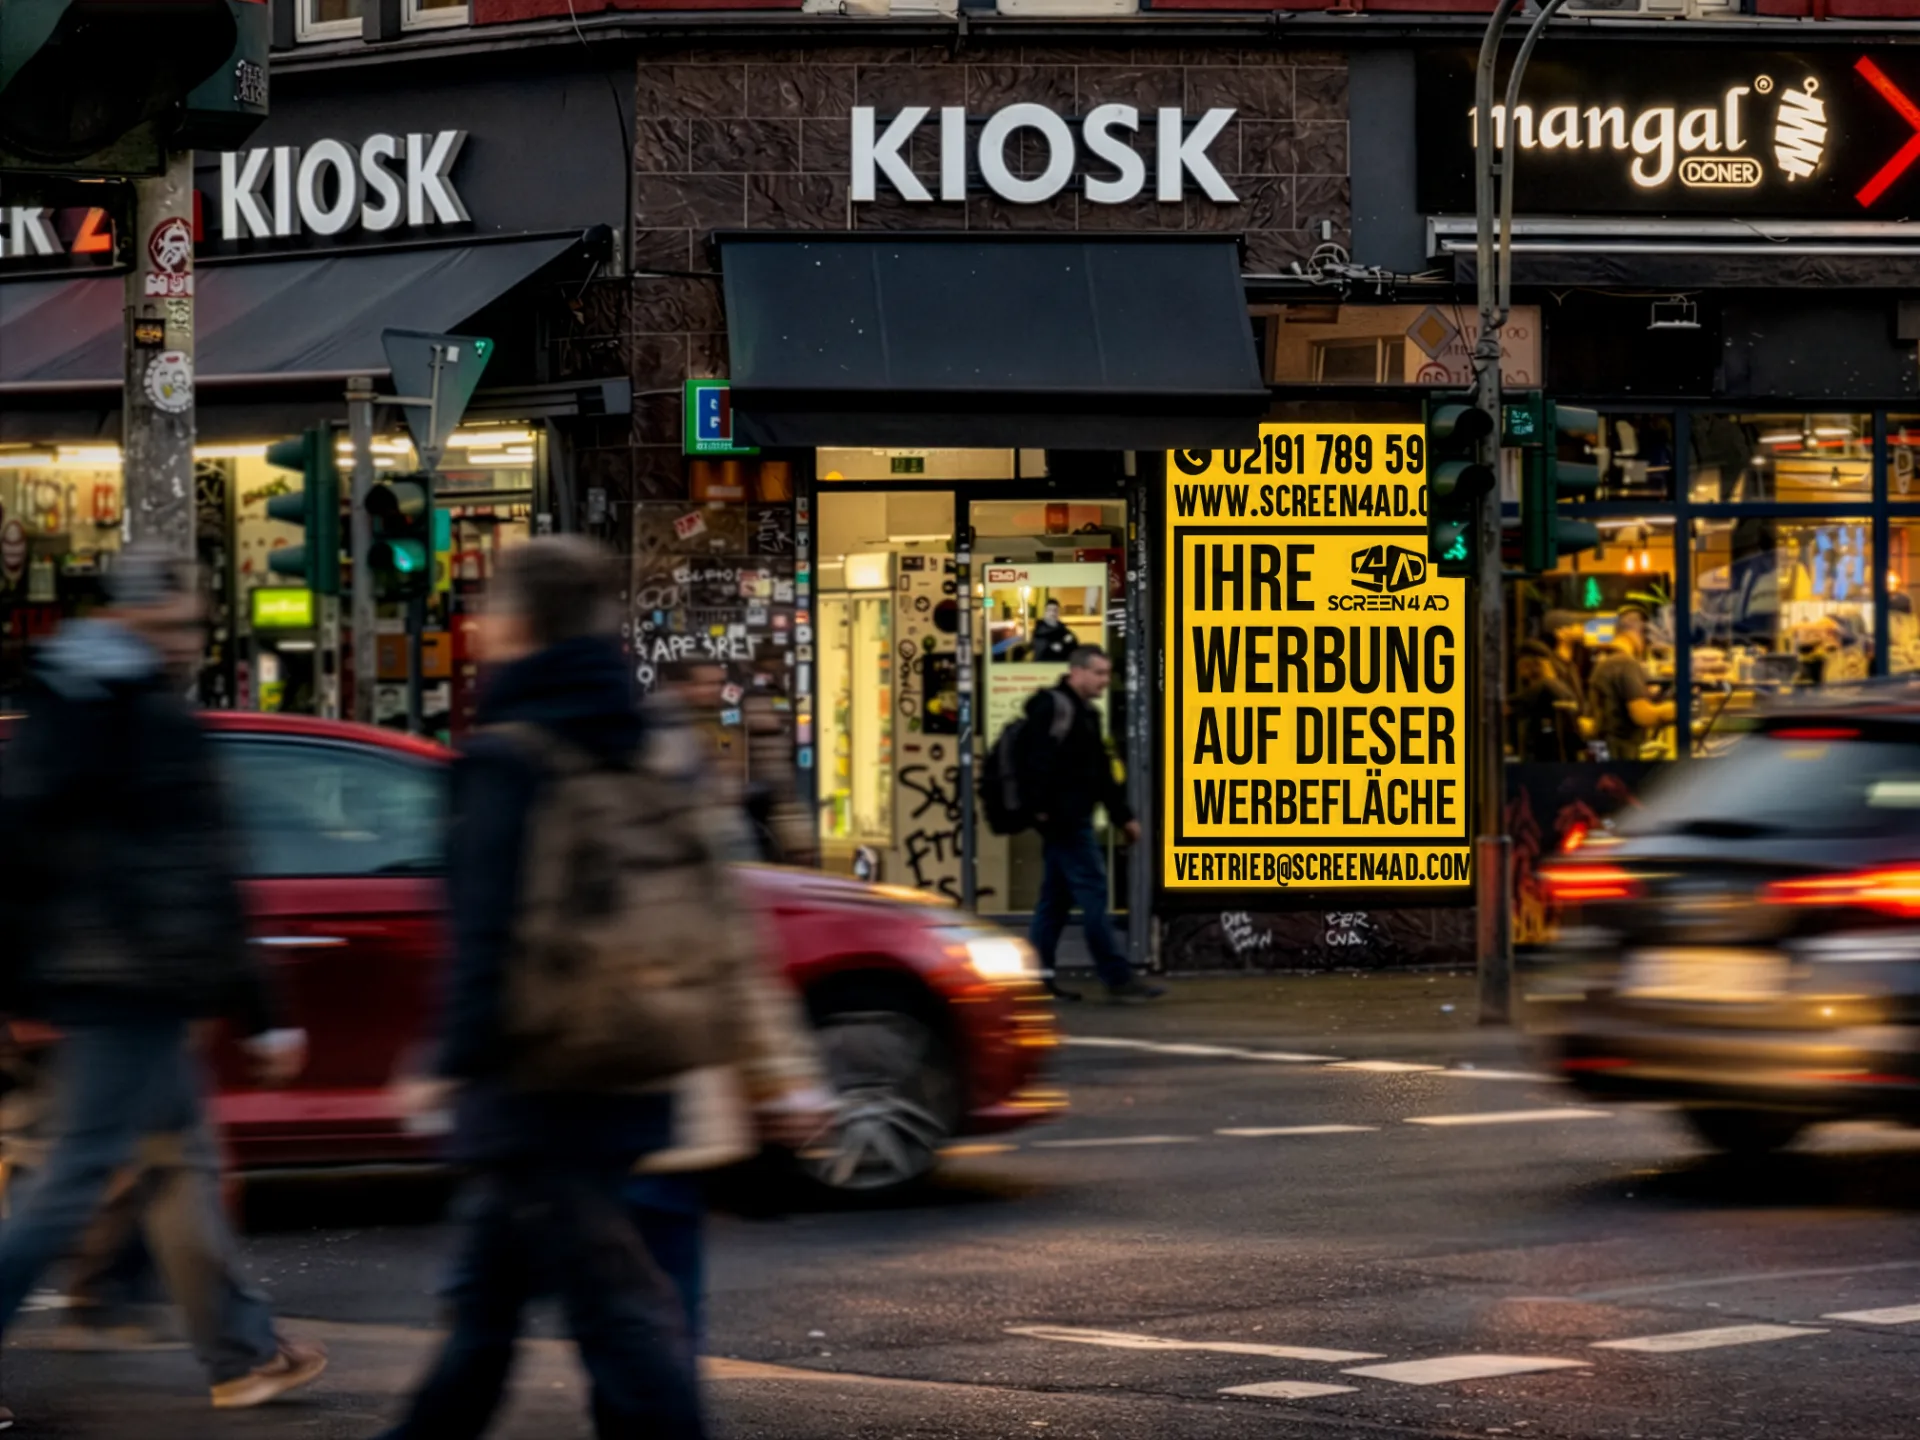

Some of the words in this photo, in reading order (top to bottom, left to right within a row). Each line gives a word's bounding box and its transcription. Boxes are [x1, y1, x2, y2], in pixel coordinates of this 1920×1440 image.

[850, 102, 1240, 204] KIOSK
[1468, 86, 1750, 187] mangal
[220, 130, 471, 241] KIOSK
[1223, 433, 1305, 475] 02191
[1316, 433, 1373, 475] 789
[1386, 433, 1424, 475] 59
[1195, 543, 1315, 612] IHRE
[1192, 625, 1456, 694] WERBUNG
[1193, 706, 1279, 765] AUF
[1296, 706, 1456, 765] DIESER
[1194, 768, 1456, 825] WERBEFLÄCHE
[1174, 852, 1471, 887] VERTRIEB@SCREEN4AD.COM
